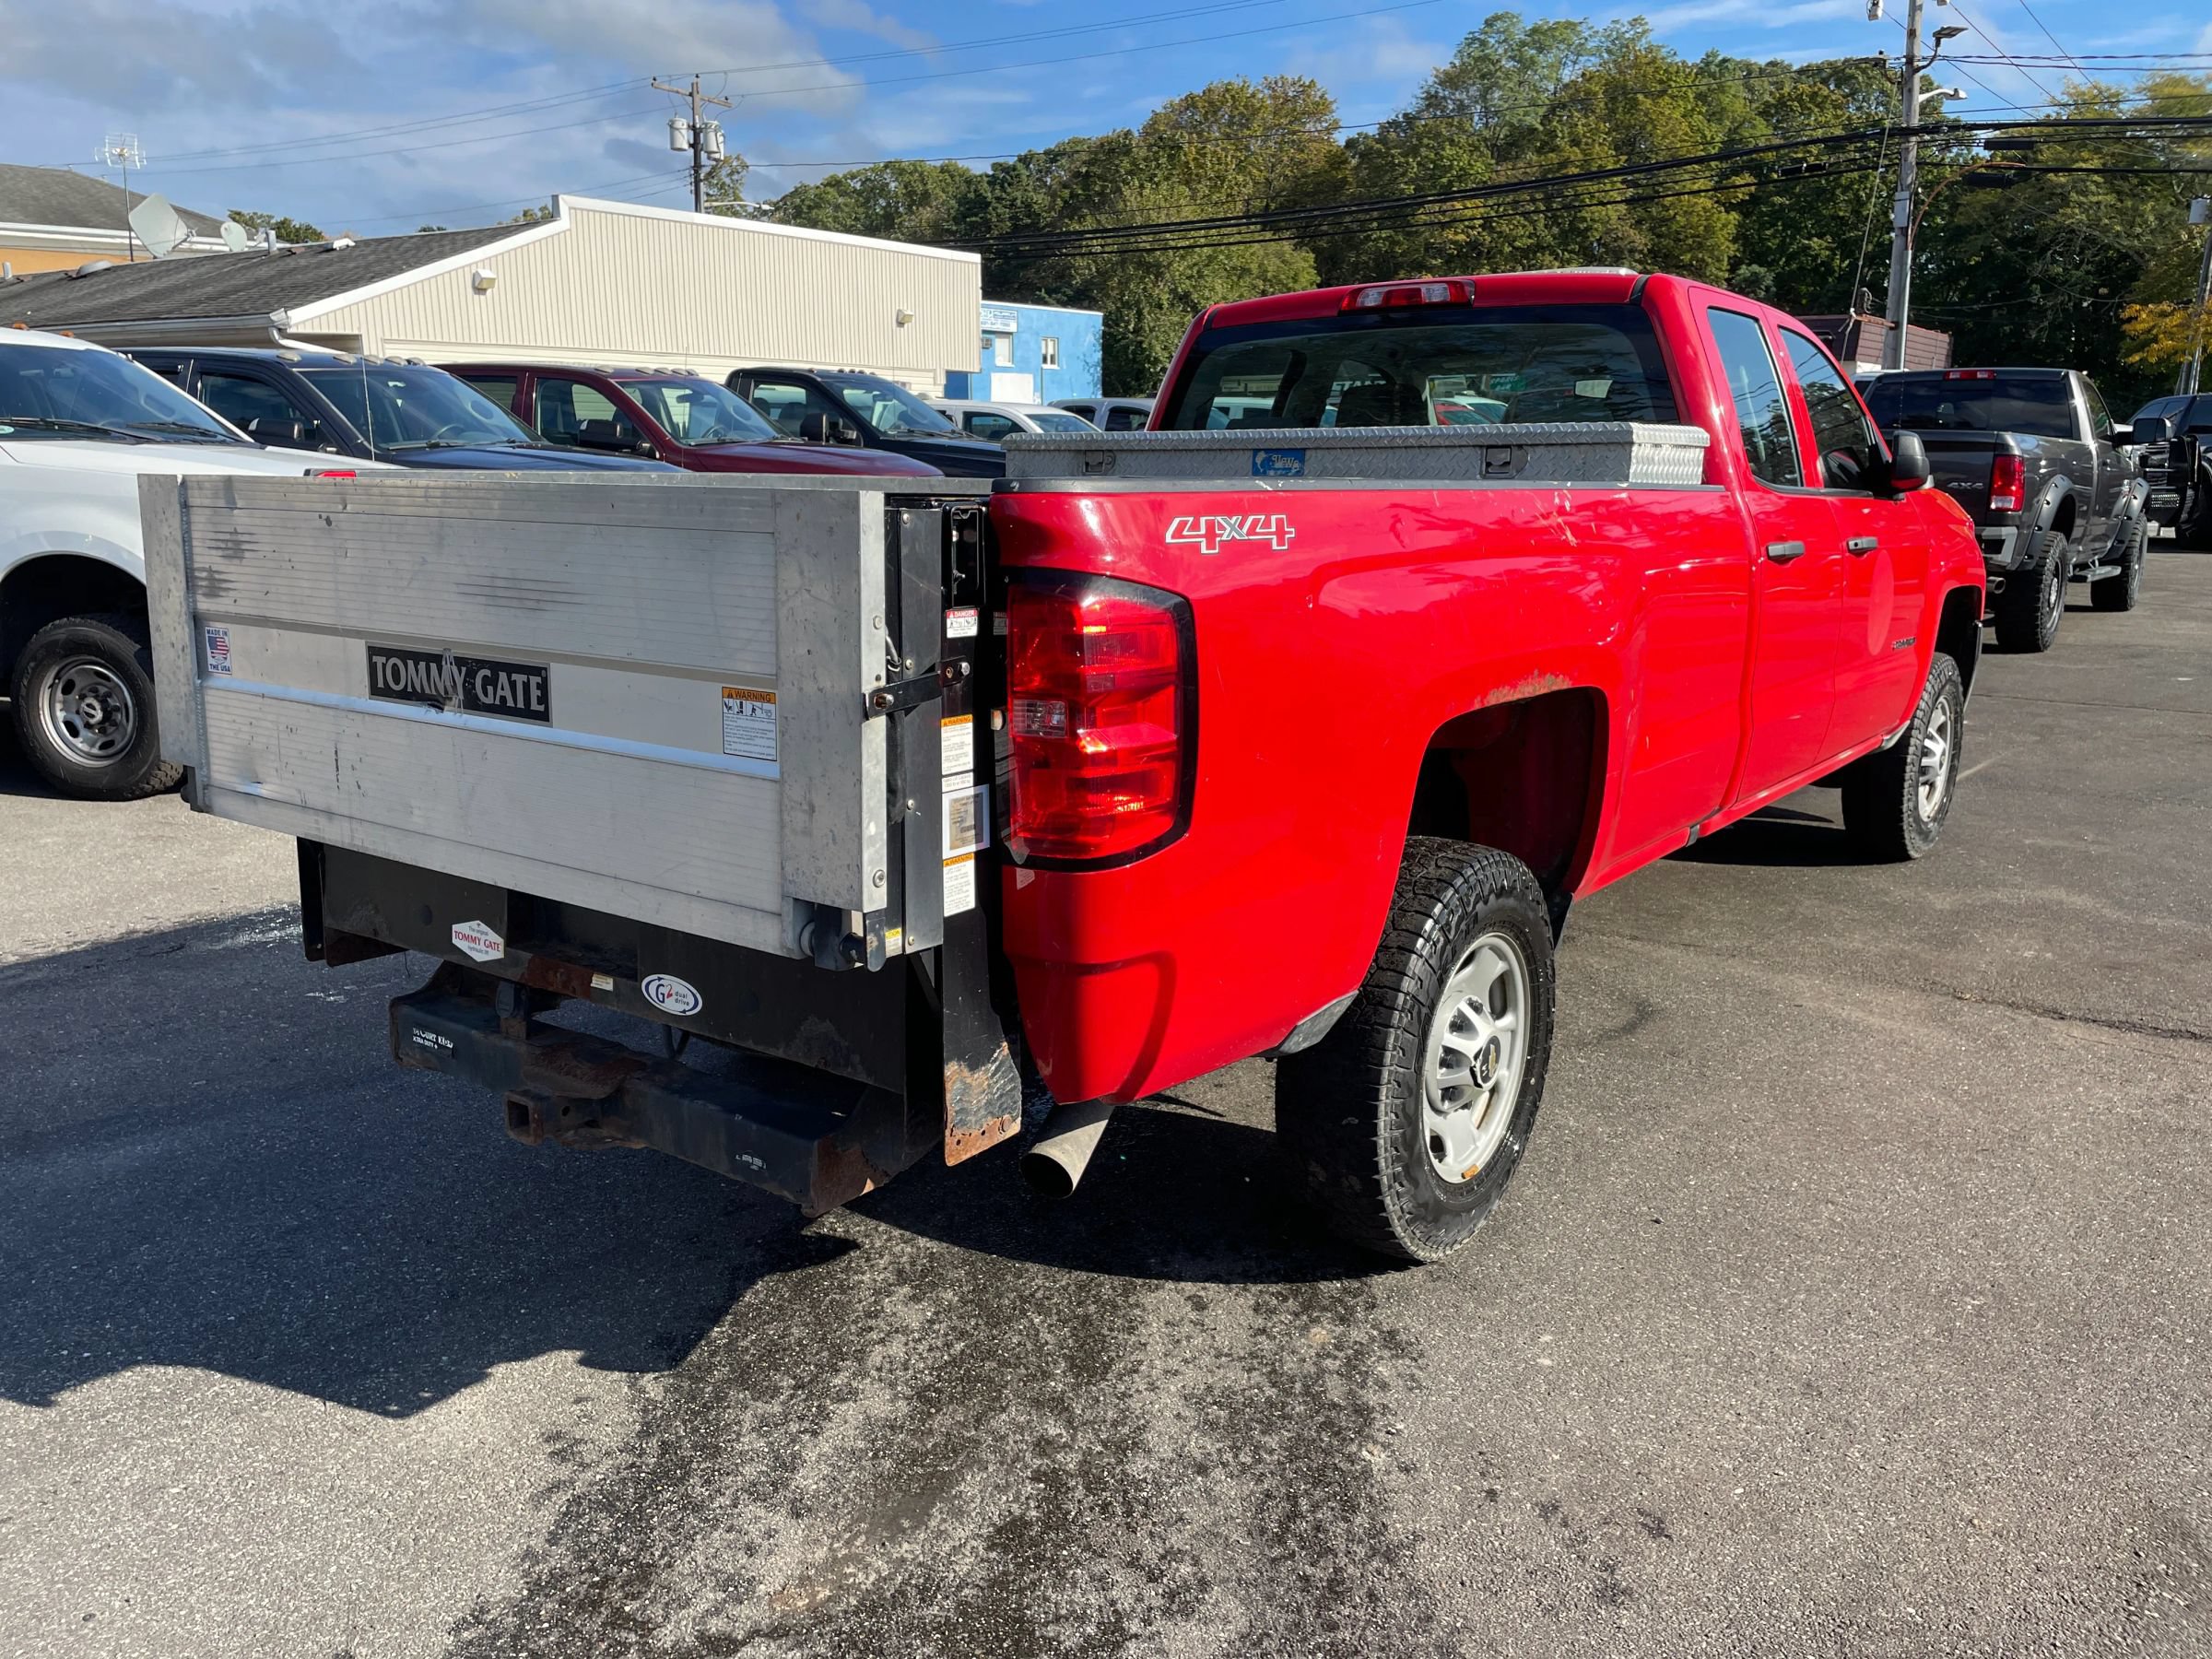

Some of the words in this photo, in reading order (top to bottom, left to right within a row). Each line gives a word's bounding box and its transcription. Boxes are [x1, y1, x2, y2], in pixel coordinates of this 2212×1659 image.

[955, 609, 975, 618] DANGER
[209, 663, 219, 671] THE
[220, 664, 231, 673] USA
[372, 655, 466, 700] TOMMY
[475, 668, 546, 712] GATE
[734, 689, 771, 702] WARNING
[453, 930, 482, 947] TOMMY
[484, 938, 502, 952] GATE
[675, 991, 688, 999] dual
[674, 997, 690, 1006] drive
